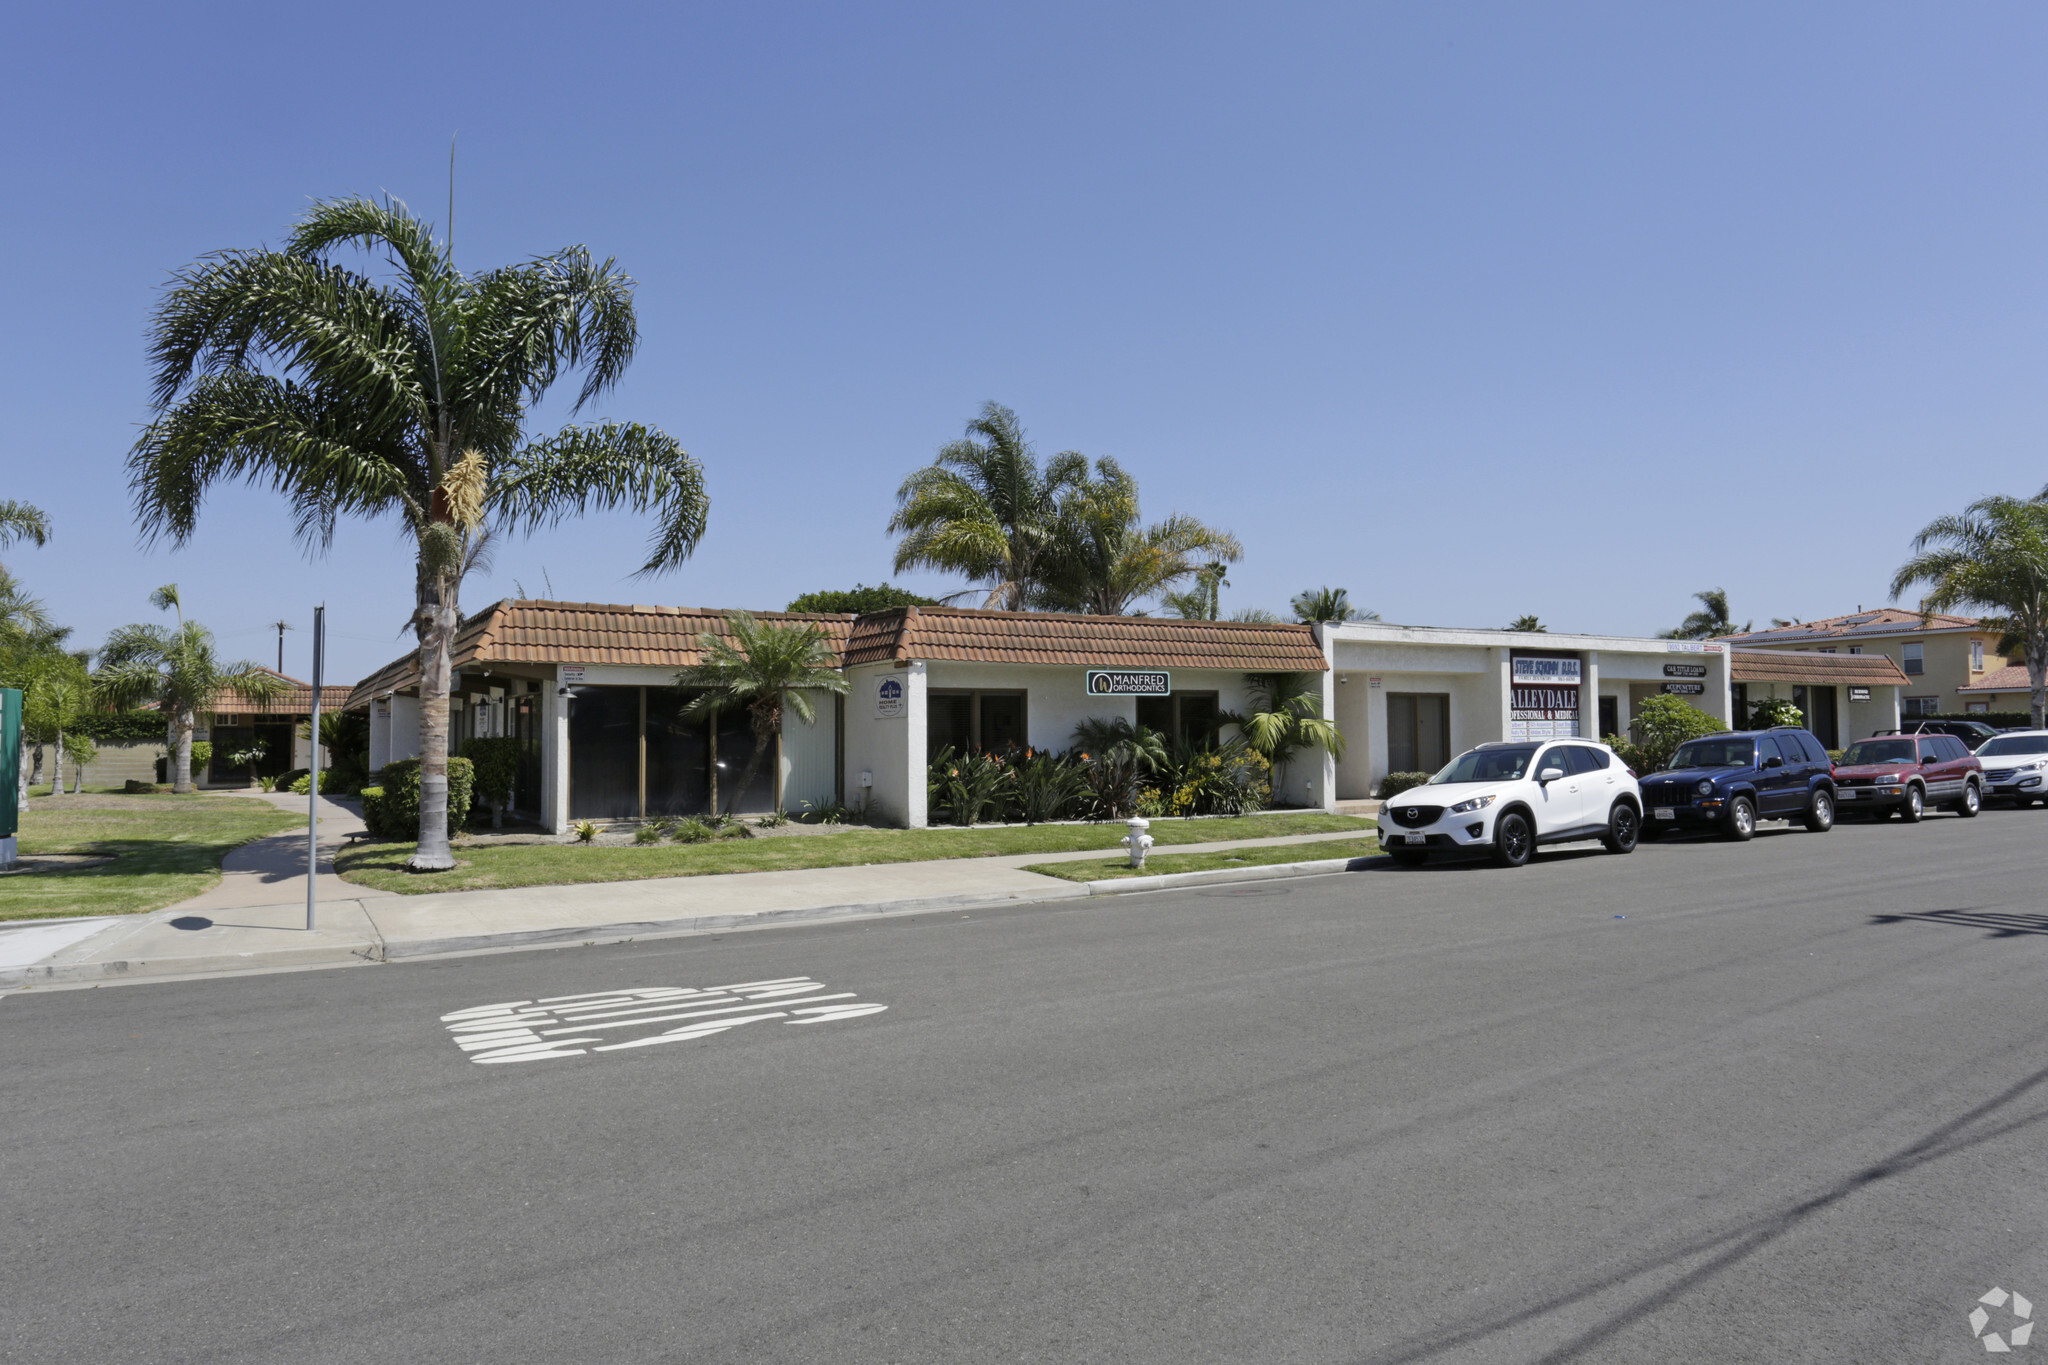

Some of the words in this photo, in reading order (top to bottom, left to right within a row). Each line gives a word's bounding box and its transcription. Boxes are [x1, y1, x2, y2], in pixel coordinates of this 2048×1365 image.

[1515, 660, 1534, 674] STEVE
[1113, 675, 1165, 685] MANFRED
[1113, 684, 1165, 692] ORTHODONTICS
[1547, 710, 1552, 719] &
[1554, 710, 1578, 720] MEDICAL
[440, 977, 889, 1064] STOP
